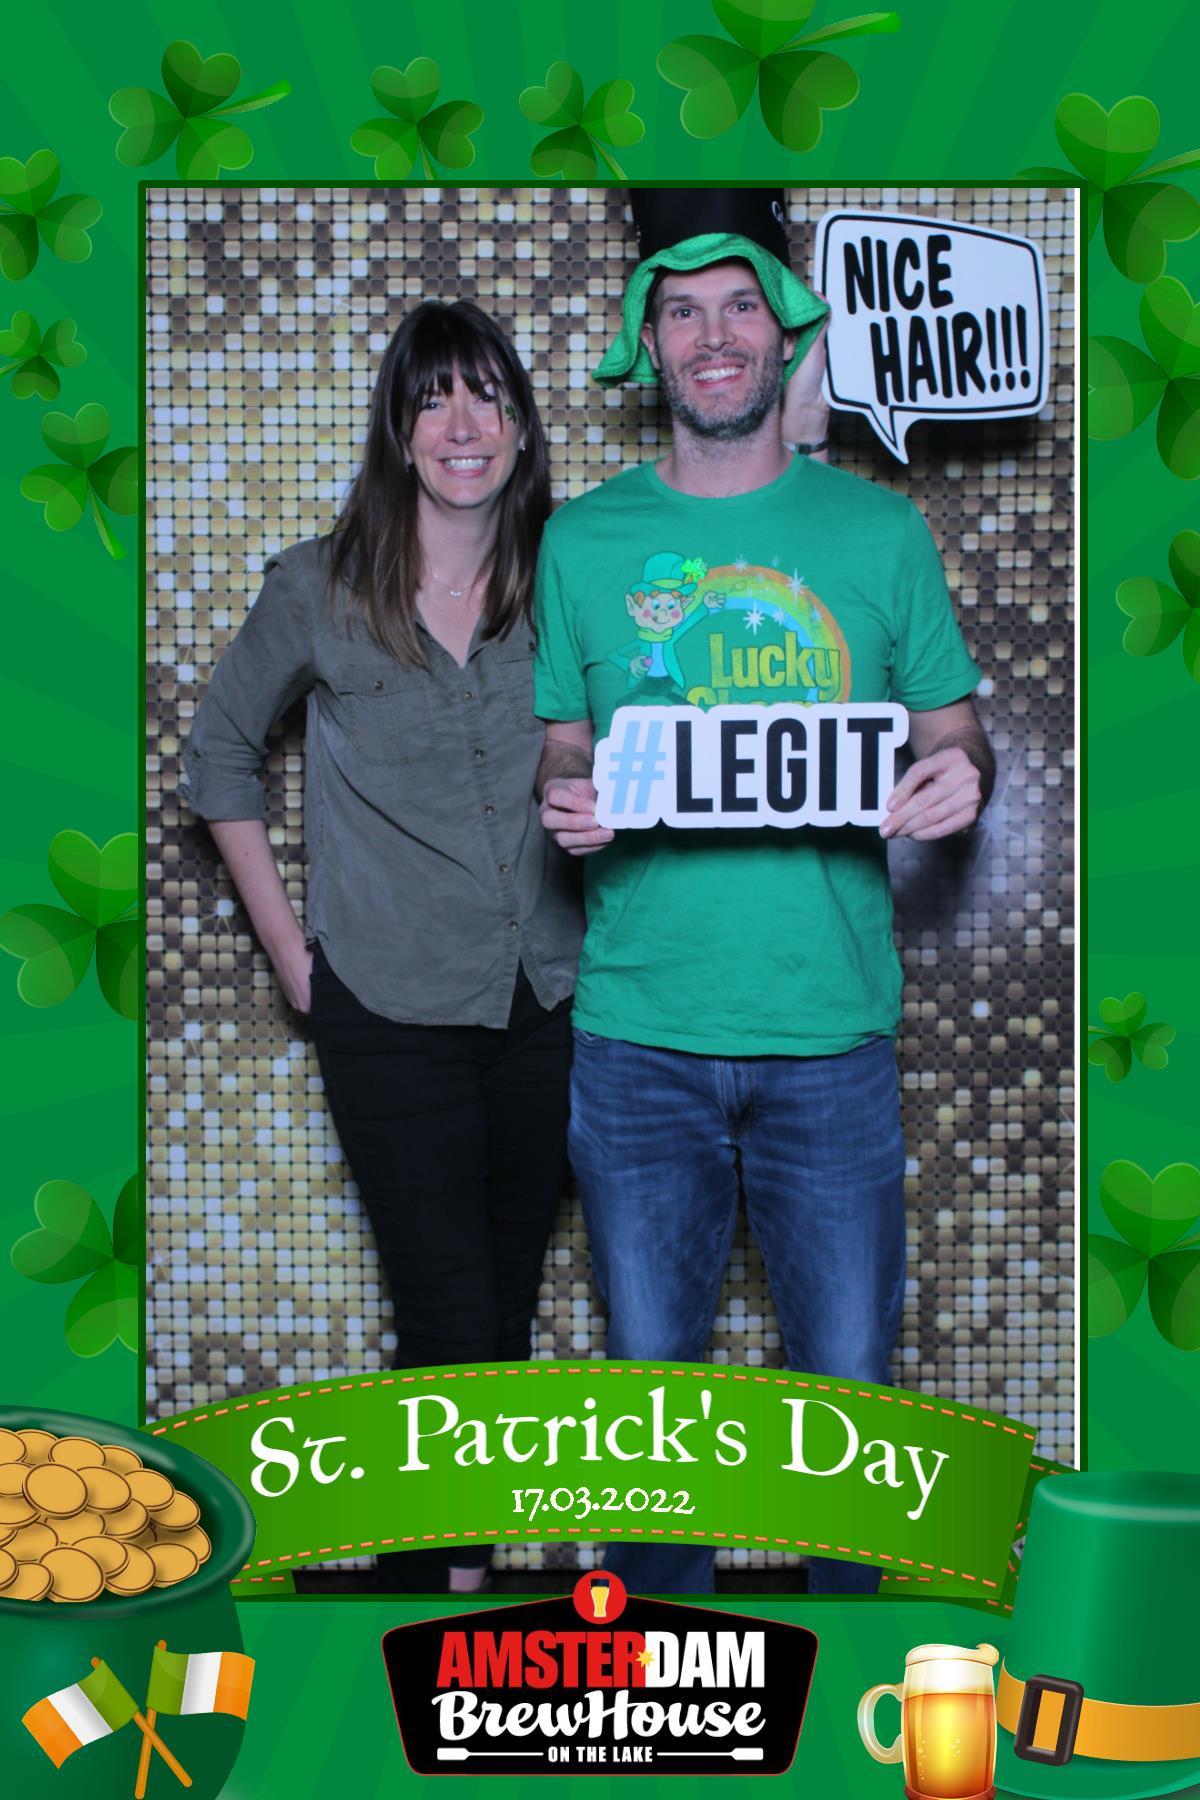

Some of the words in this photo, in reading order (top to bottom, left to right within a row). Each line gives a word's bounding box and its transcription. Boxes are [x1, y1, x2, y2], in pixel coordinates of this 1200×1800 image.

[843, 234, 954, 315] NICE
[870, 304, 1031, 406] HAIR!!!
[708, 631, 841, 702] Lucky
[608, 717, 894, 814] #LEGIT
